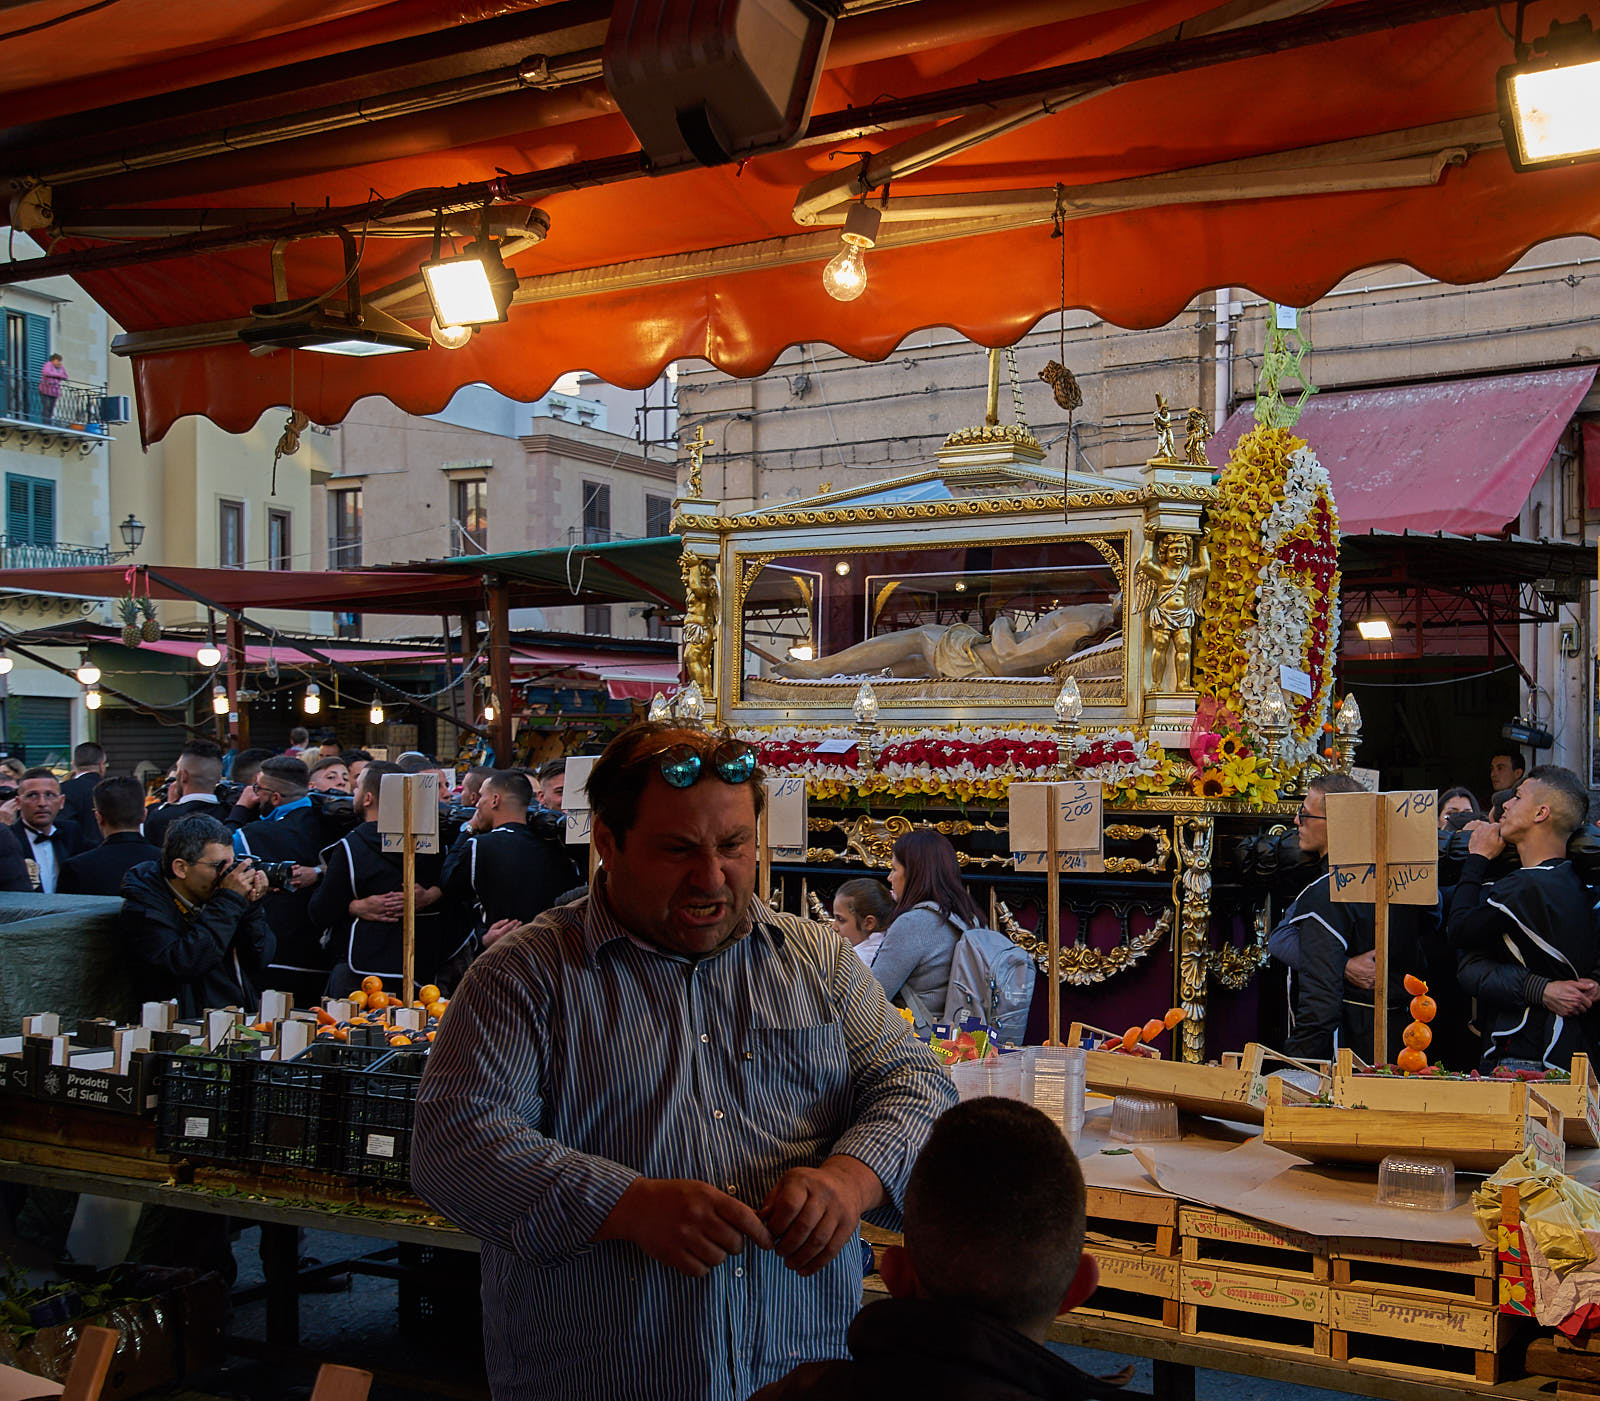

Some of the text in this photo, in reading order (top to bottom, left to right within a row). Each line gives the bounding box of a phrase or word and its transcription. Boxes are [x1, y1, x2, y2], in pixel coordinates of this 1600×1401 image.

[774, 779, 801, 798] 130
[1073, 781, 1088, 800] 3
[1060, 801, 1093, 822] 200
[1395, 792, 1434, 818] 180
[66, 1073, 110, 1090] Prodotti
[66, 1087, 109, 1104] di Sicilia
[1372, 1302, 1468, 1333] Menditto
